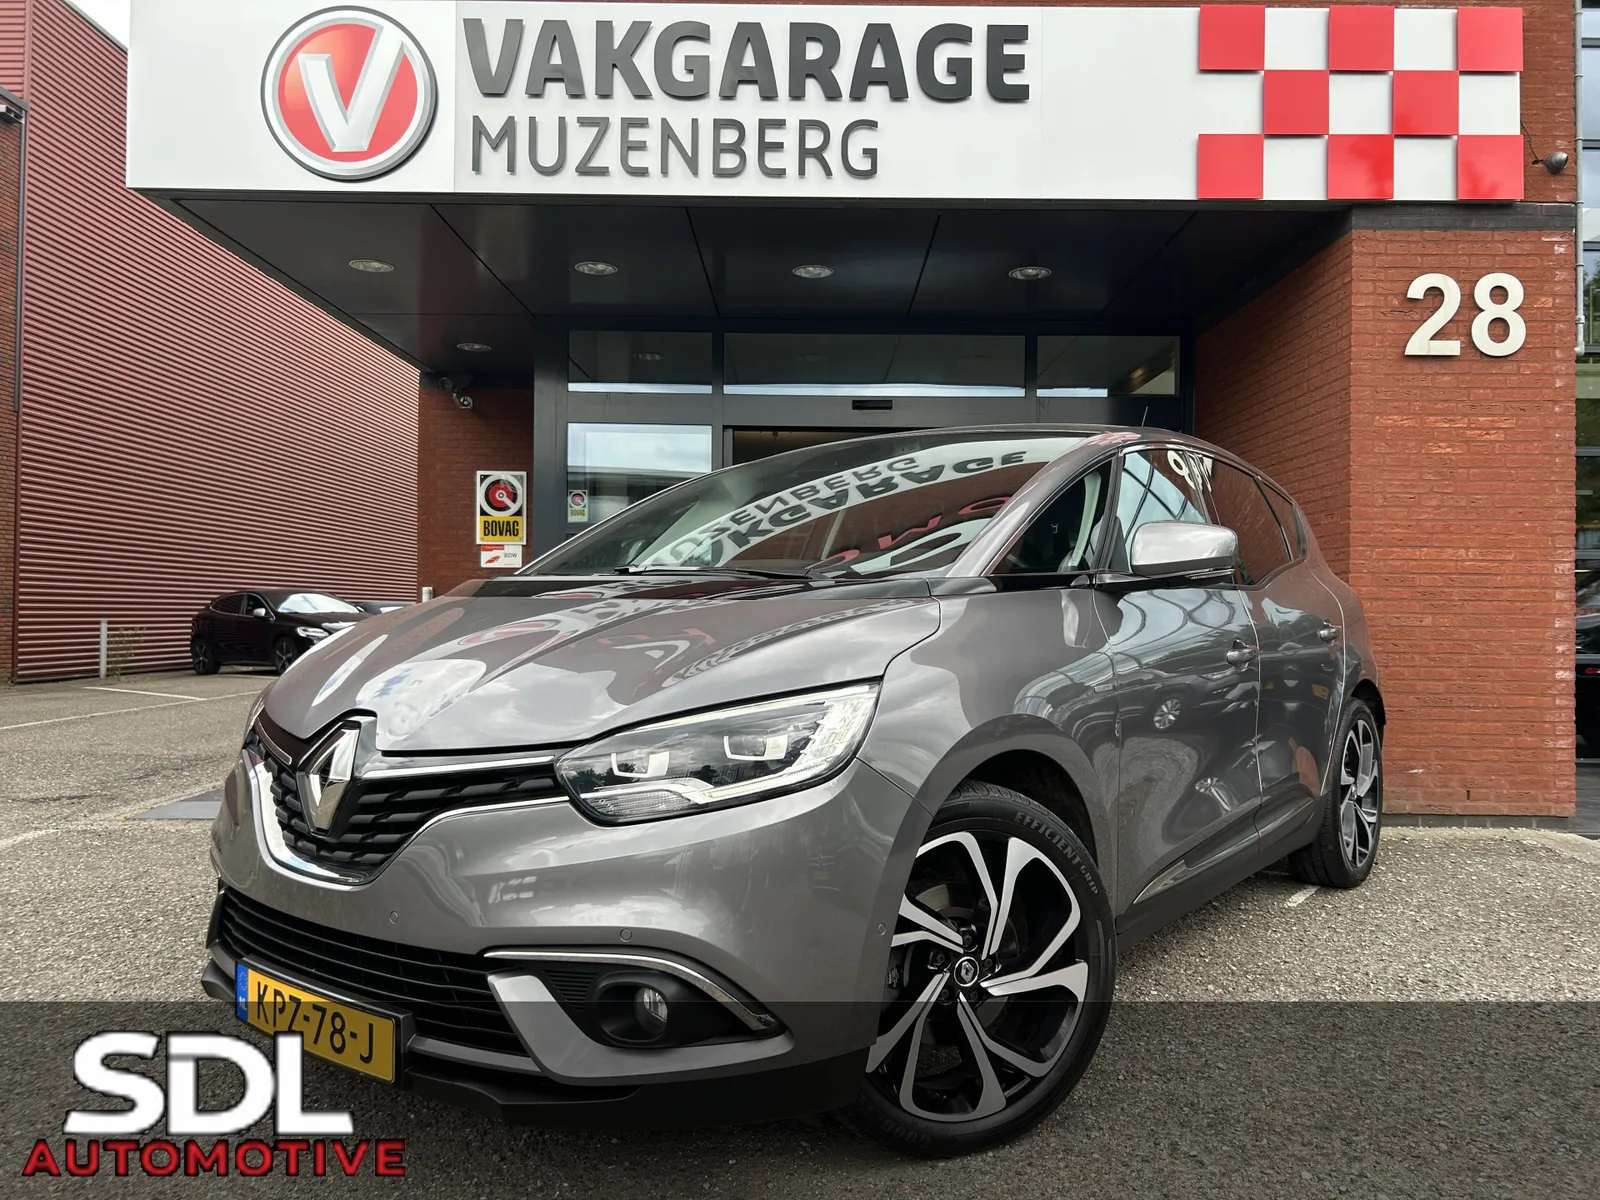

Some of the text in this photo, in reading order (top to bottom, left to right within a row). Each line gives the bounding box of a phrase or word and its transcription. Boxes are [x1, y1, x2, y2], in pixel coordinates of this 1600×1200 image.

[296, 26, 404, 152] V
[463, 18, 1030, 102] VAKGARAGE
[471, 115, 879, 179] MUZENBERG
[1404, 272, 1527, 357] 28
[483, 520, 519, 537] BOVAG
[570, 508, 586, 517] BOVAG
[1015, 811, 1099, 894] EFFICIENT GRIP
[257, 981, 374, 1064] KPZ-78-J
